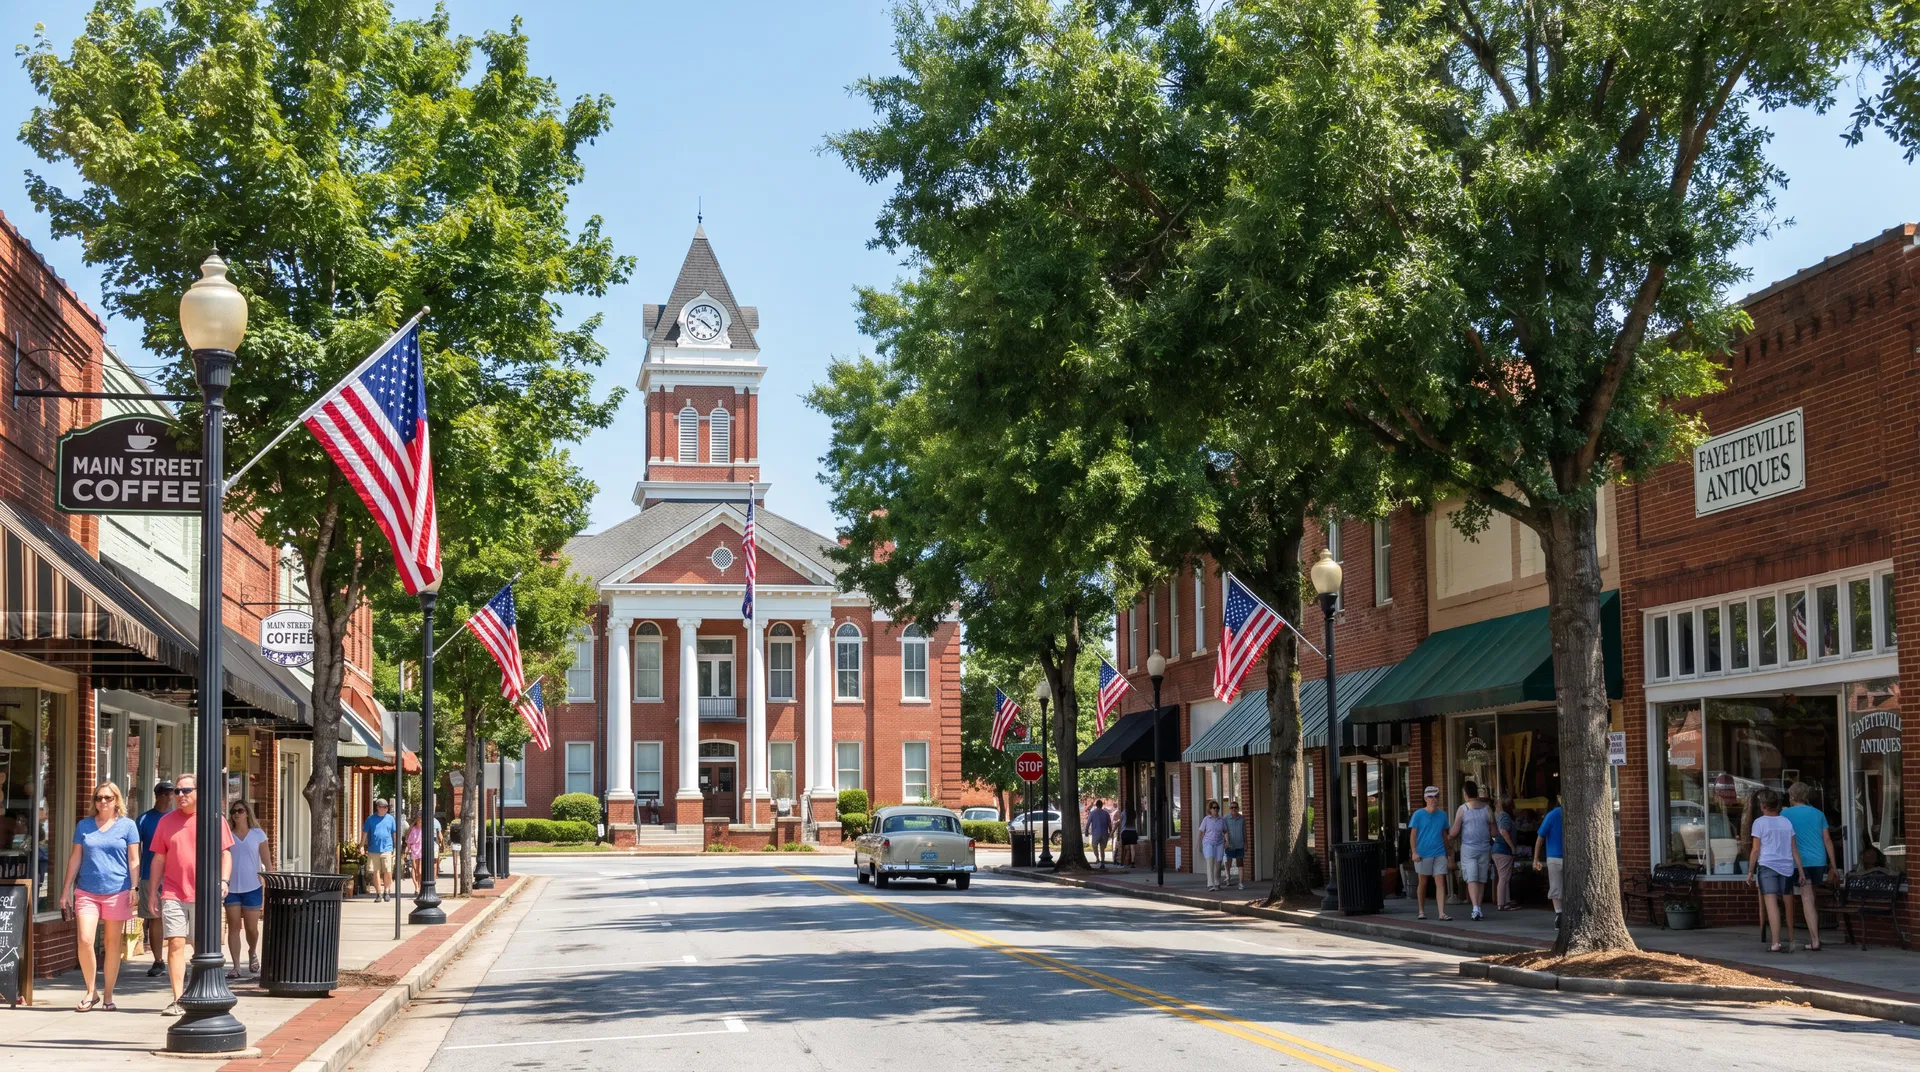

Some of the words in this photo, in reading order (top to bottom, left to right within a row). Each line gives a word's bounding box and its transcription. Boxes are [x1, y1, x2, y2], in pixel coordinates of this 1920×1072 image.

[1698, 421, 1796, 473] FAYETTEVILLE
[73, 456, 124, 475] MAIN
[130, 457, 203, 477] STREET
[1706, 452, 1790, 503] ANTIQUES
[72, 478, 200, 503] COFFEE
[267, 621, 285, 629] MAIN
[1850, 711, 1902, 740] FAYETTEVILL
[1859, 737, 1902, 755] ANTIQUES
[1018, 761, 1043, 772] STOP
